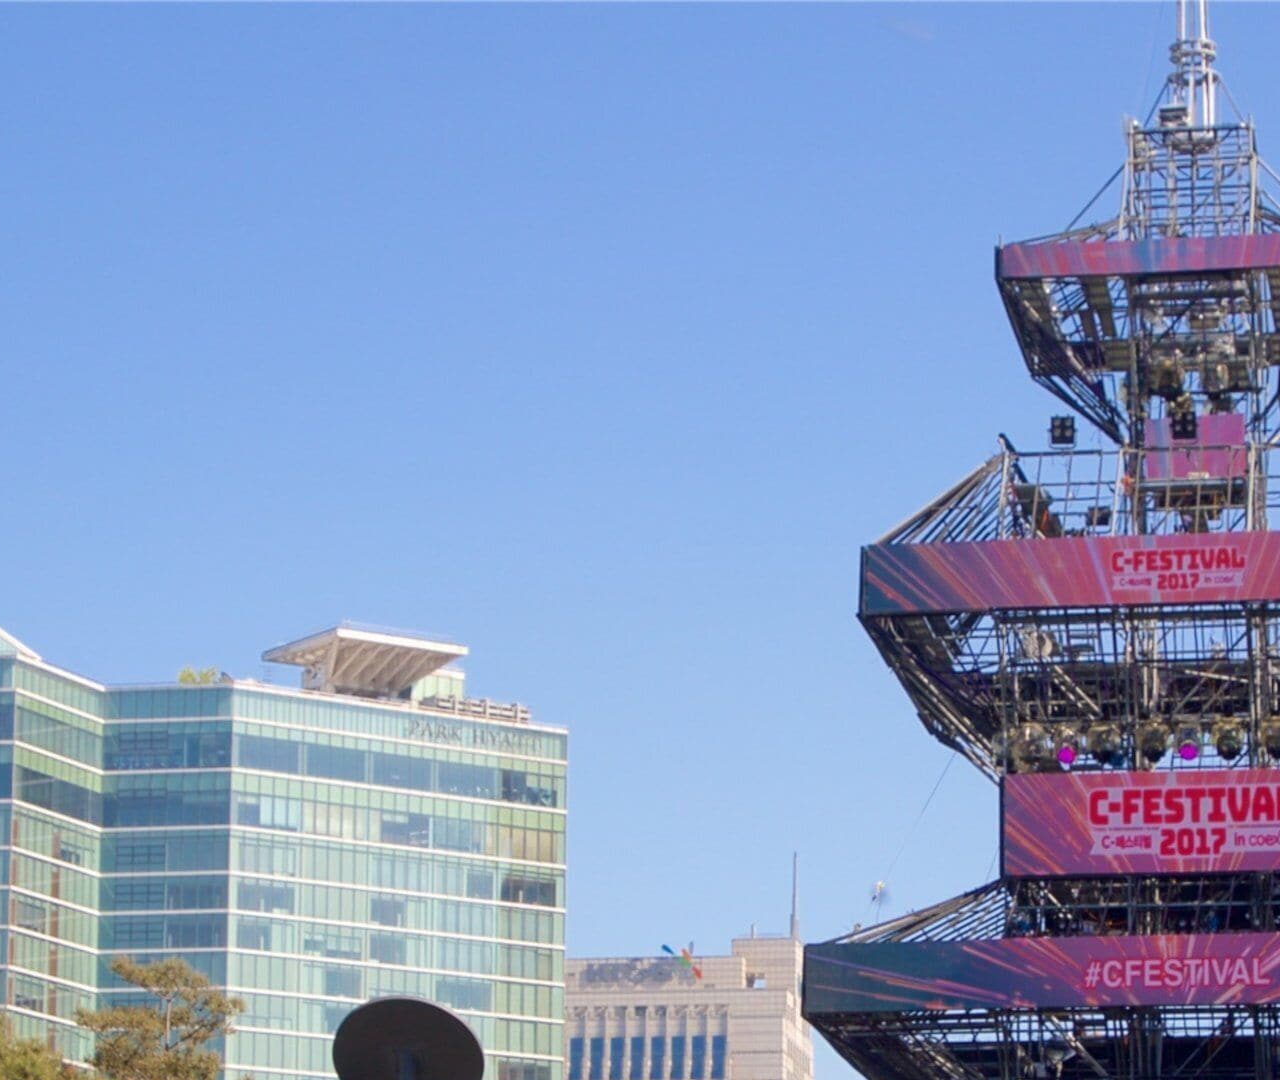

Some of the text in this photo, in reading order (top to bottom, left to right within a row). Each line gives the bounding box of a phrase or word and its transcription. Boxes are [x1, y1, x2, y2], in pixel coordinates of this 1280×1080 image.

[1111, 548, 1246, 573] C-FESTIVAL
[1157, 573, 1200, 590] 2017
[1159, 828, 1227, 856] 2017
[1233, 831, 1246, 847] in
[1085, 957, 1271, 988] #CFESTIVAL
